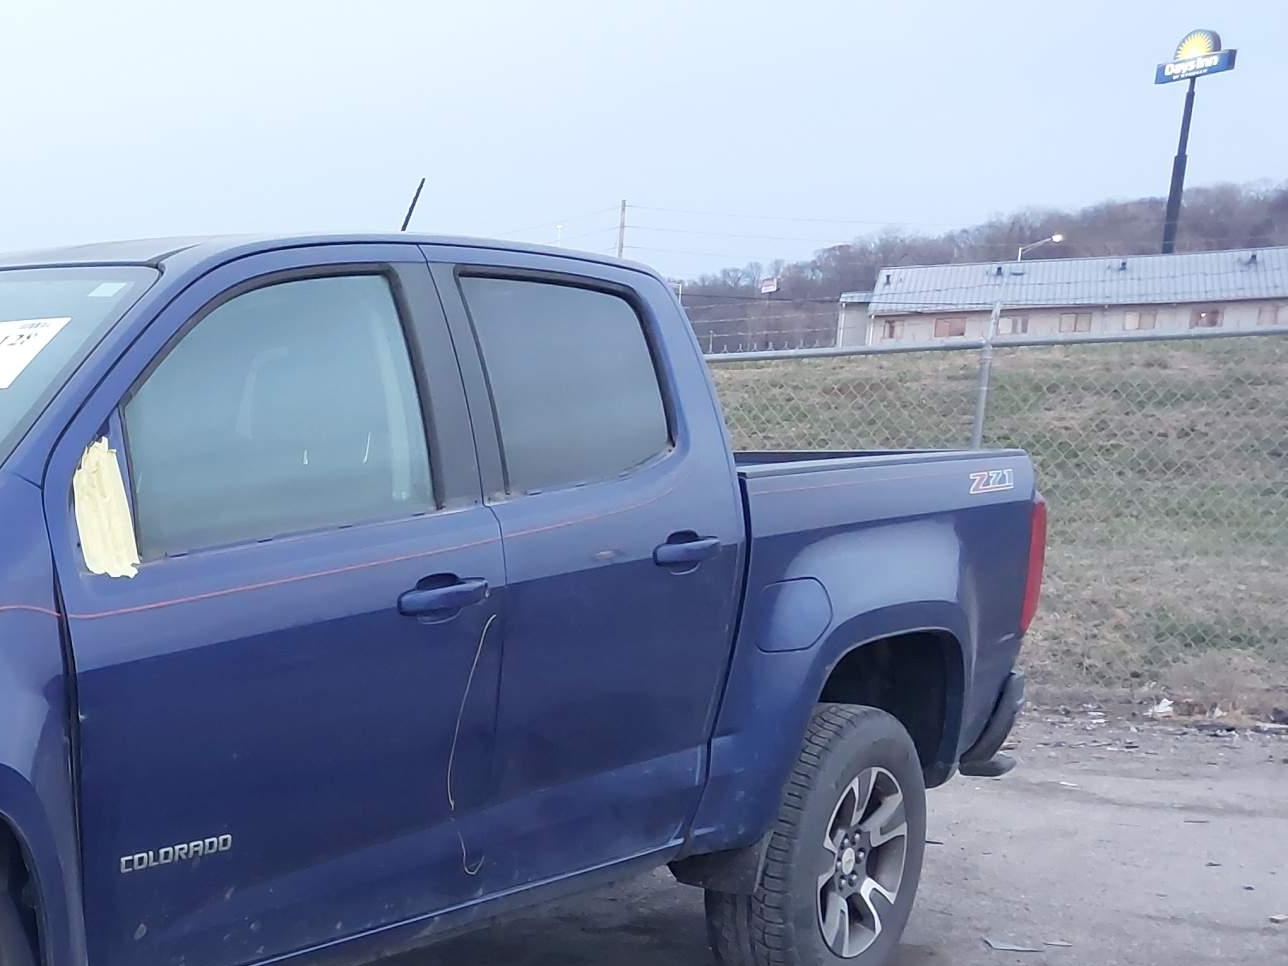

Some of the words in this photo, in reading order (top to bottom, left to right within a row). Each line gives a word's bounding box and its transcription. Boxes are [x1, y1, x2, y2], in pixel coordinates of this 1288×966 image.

[1164, 60, 1196, 77] Days
[969, 468, 1015, 494] Z71
[120, 834, 232, 873] COLORADO
